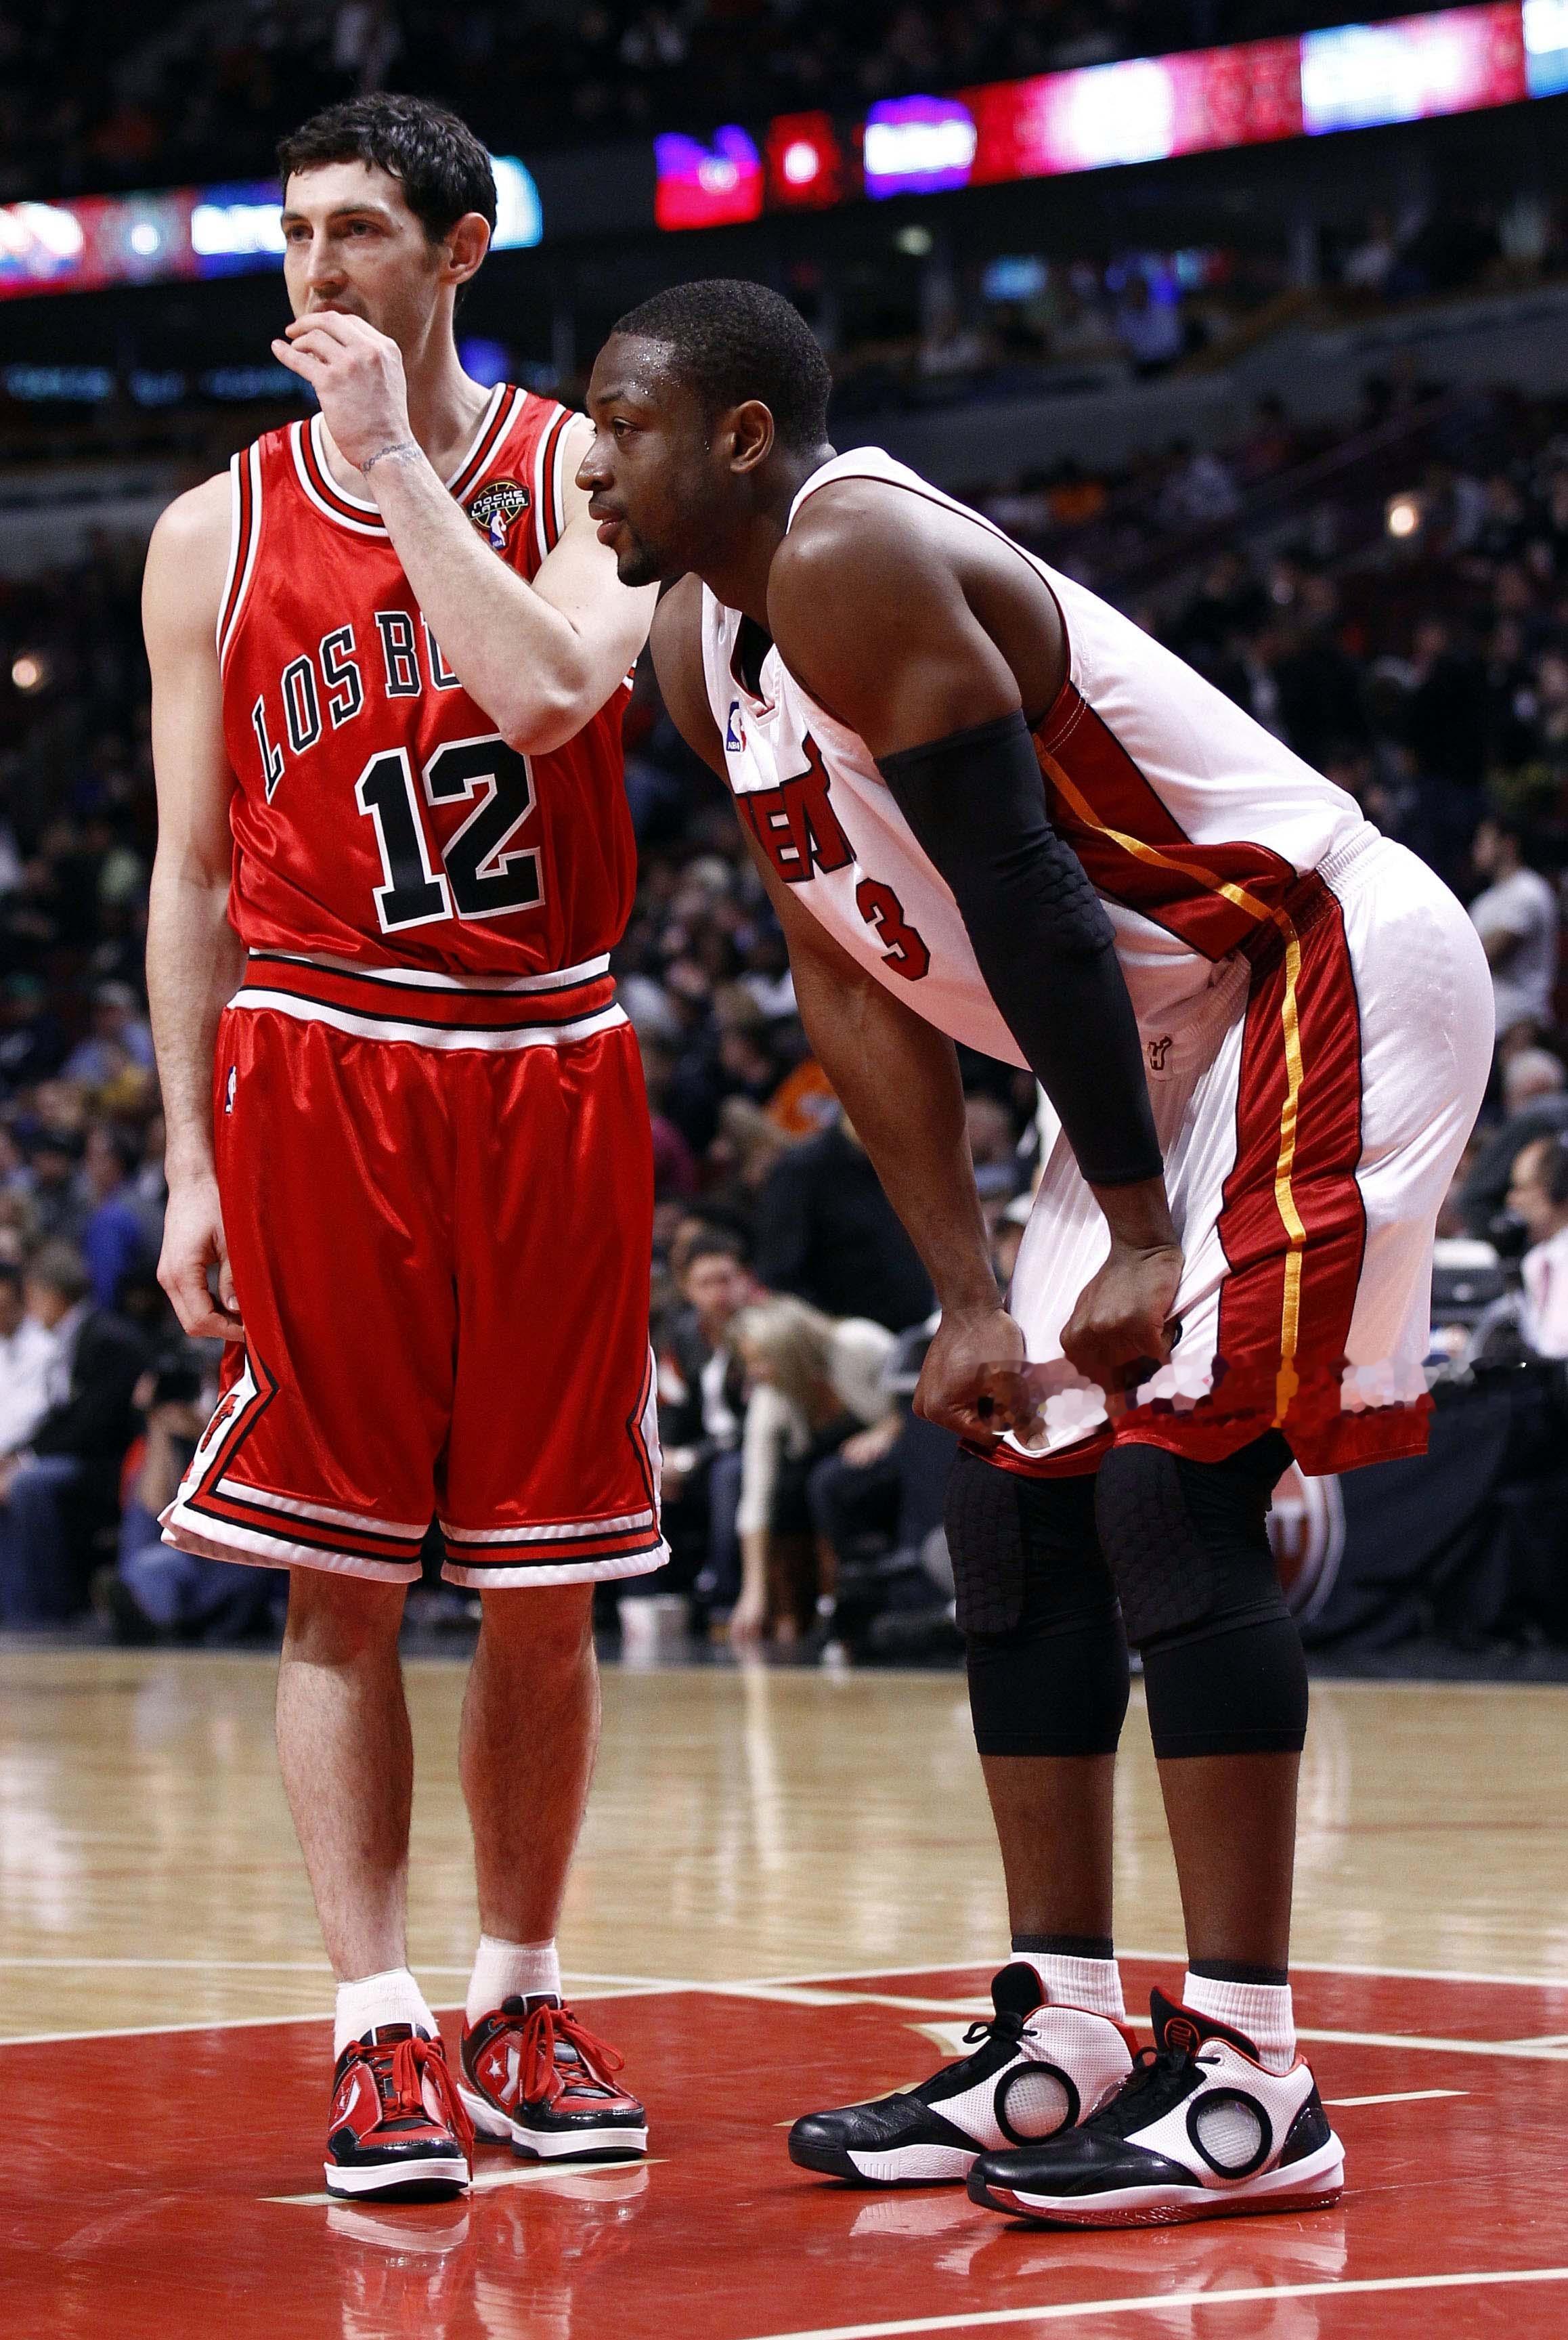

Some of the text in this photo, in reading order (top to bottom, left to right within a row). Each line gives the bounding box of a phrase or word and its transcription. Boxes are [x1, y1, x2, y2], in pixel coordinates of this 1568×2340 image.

[471, 498, 525, 517] LATINA
[473, 490, 523, 509] NOCHE
[253, 624, 364, 804] LOS
[355, 733, 546, 934] 12
[735, 731, 857, 882] EA
[856, 878, 931, 981] 3
